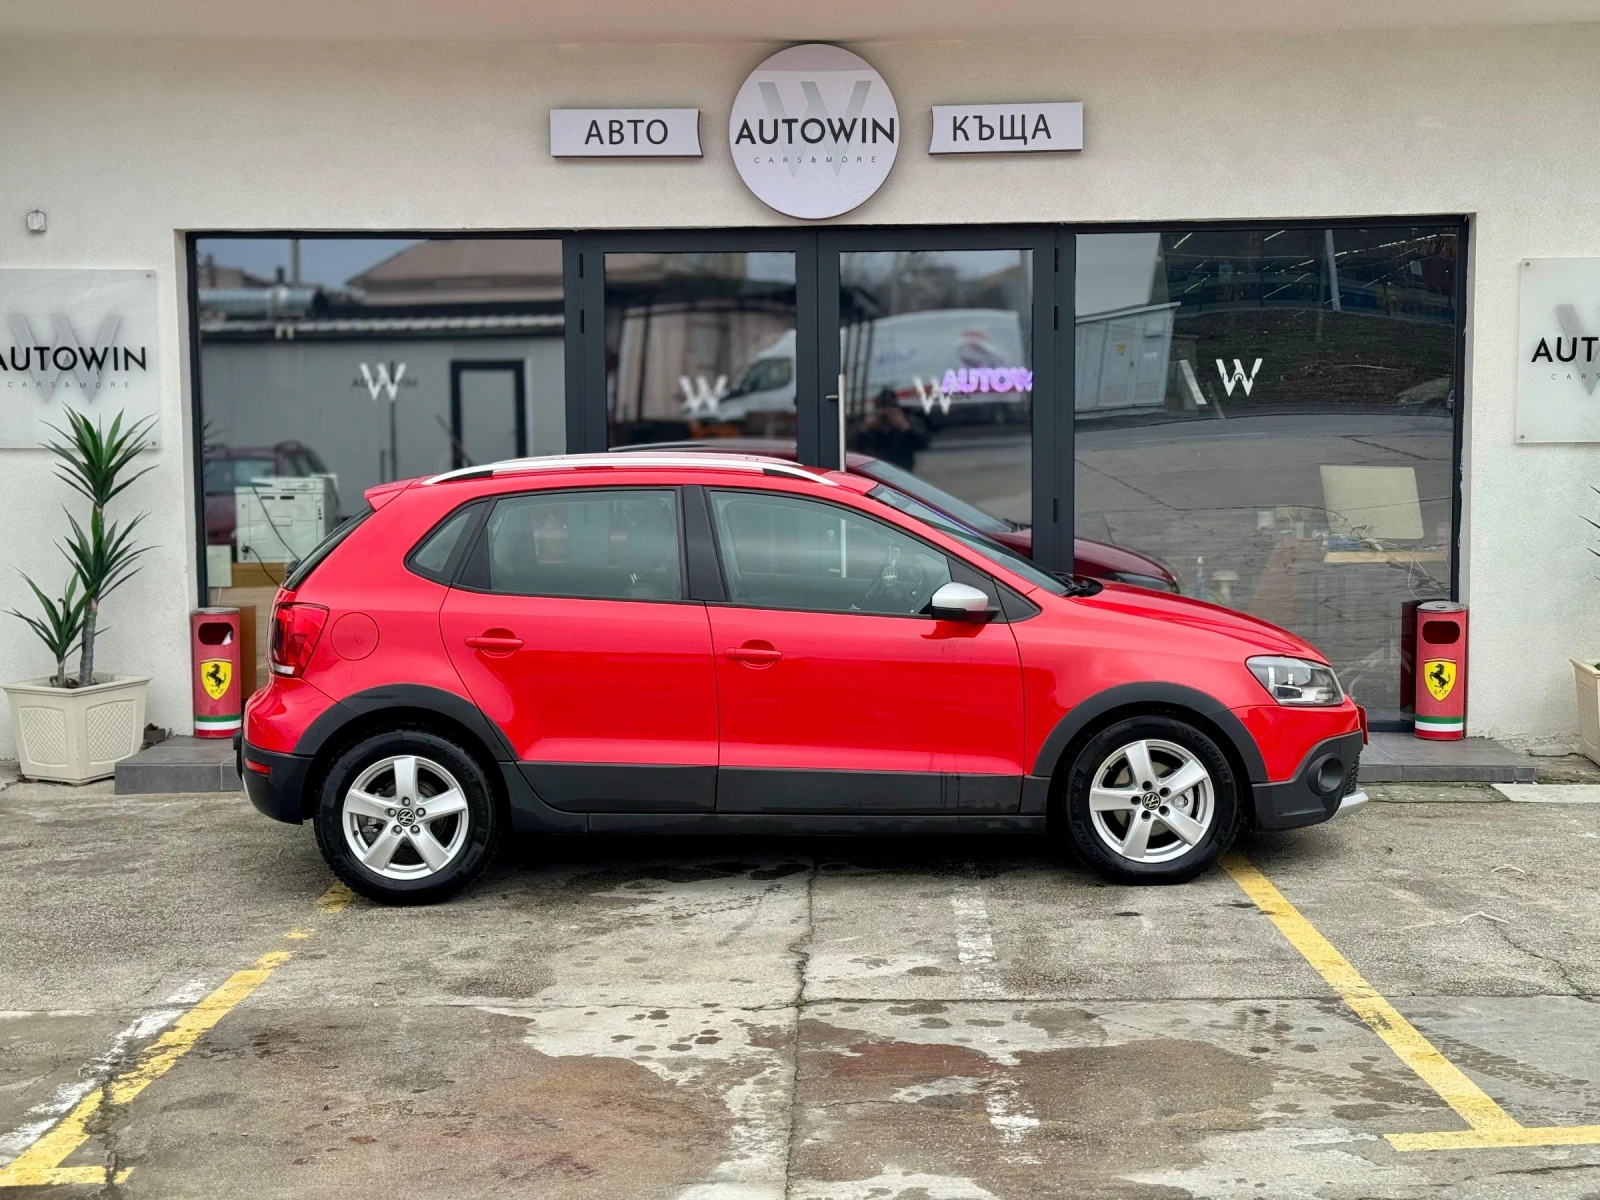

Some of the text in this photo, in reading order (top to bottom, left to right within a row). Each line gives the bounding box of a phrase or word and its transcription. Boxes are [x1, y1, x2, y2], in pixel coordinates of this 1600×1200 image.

[584, 119, 669, 145] АВТО
[735, 117, 895, 145] AUTOWIN
[952, 113, 1052, 146] КЪЩА
[1531, 336, 1599, 362] AUT
[360, 362, 407, 401] W
[1215, 358, 1263, 397] W
